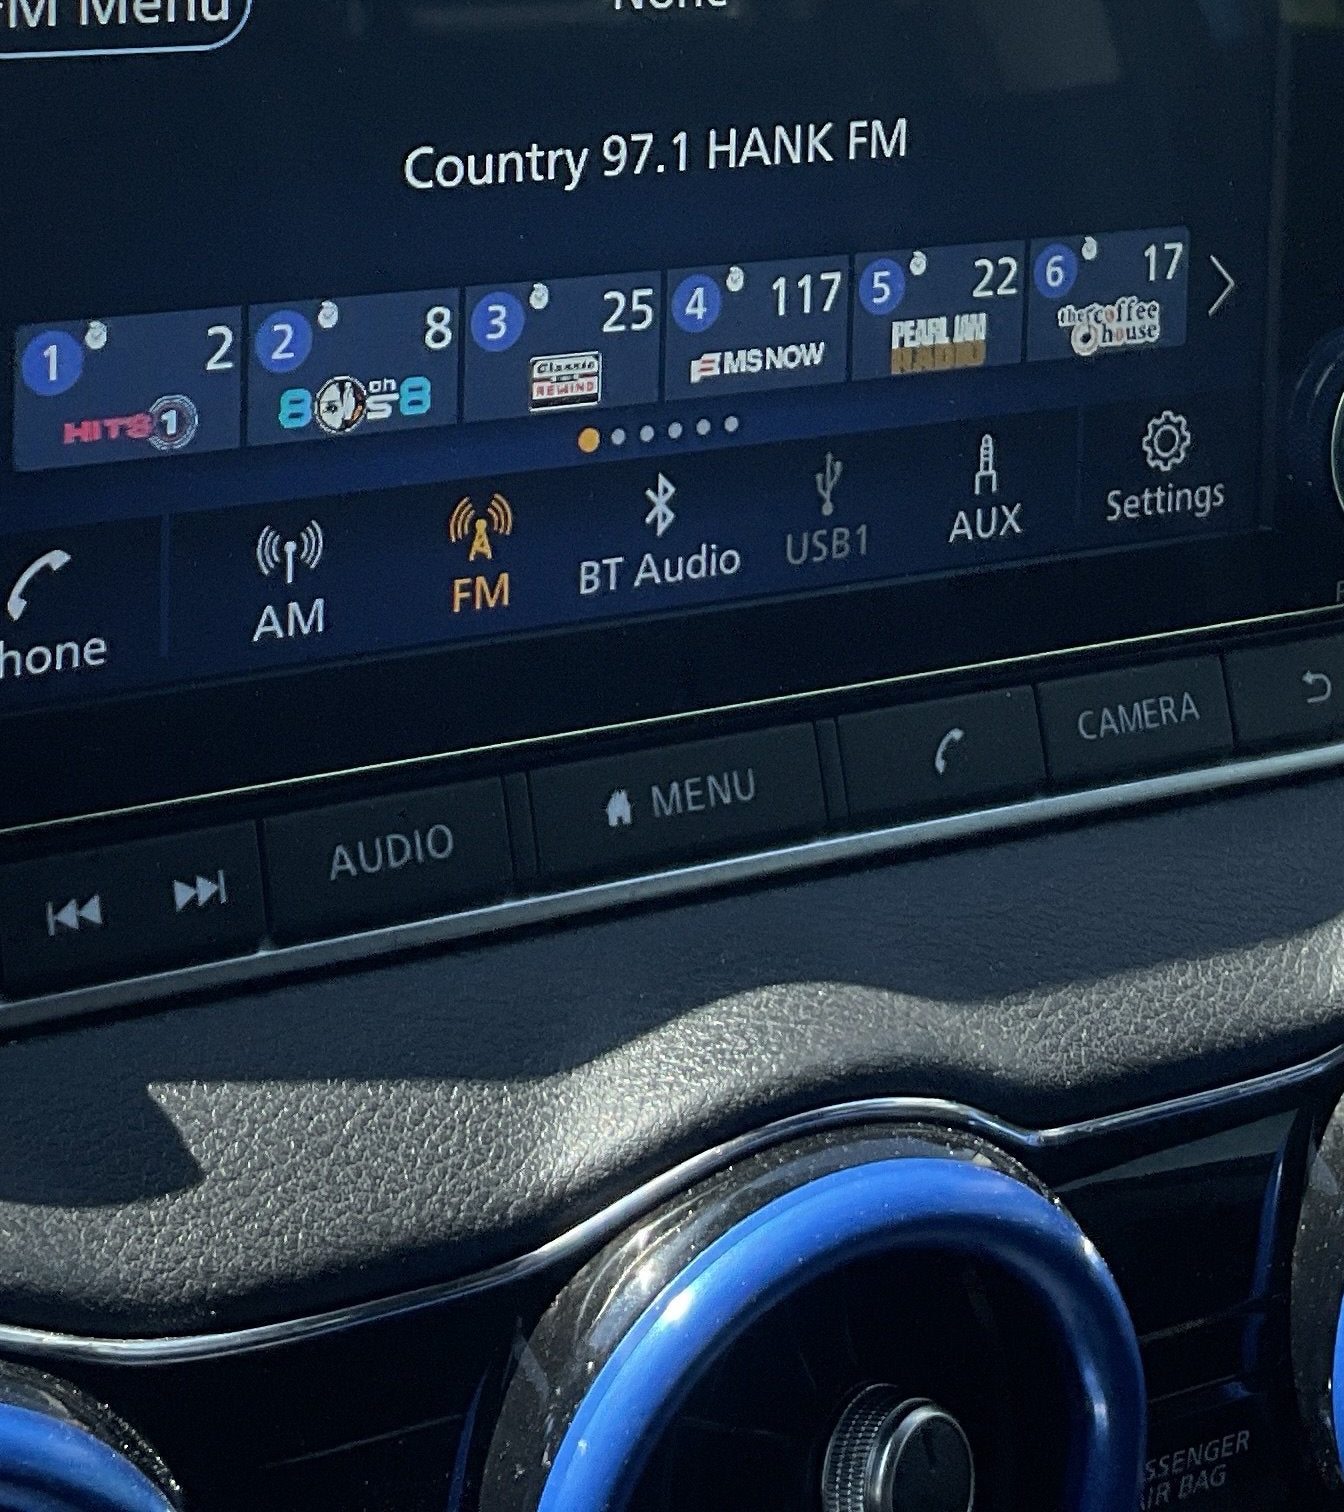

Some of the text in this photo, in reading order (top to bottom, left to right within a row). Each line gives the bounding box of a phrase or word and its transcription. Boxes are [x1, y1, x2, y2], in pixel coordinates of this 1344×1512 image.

[403, 117, 908, 192] Country 97.1 HANK FM
[972, 255, 1019, 298] 22
[1044, 254, 1064, 288] 6
[1143, 241, 1184, 282] 17
[684, 287, 708, 321] 4
[771, 271, 842, 317] 117
[870, 270, 892, 305] 5
[423, 305, 453, 350] 8
[484, 304, 508, 340] 3
[602, 288, 654, 333] 25
[205, 324, 235, 371] 2
[270, 324, 297, 361] 2
[1102, 323, 1158, 344] house
[42, 343, 58, 382] 1
[536, 381, 594, 397] REWIND
[1106, 480, 1226, 522] Settings
[785, 523, 870, 566] USB1
[948, 503, 1023, 544] AUX
[579, 541, 742, 595] BT Audio
[452, 573, 511, 614] FM
[253, 598, 326, 643] AM
[1076, 691, 1202, 741] CAMERA
[650, 767, 758, 819] MENU
[329, 823, 454, 882] AUDIO
[1145, 1429, 1252, 1481] SSENGER
[1177, 1463, 1227, 1500] BAG
